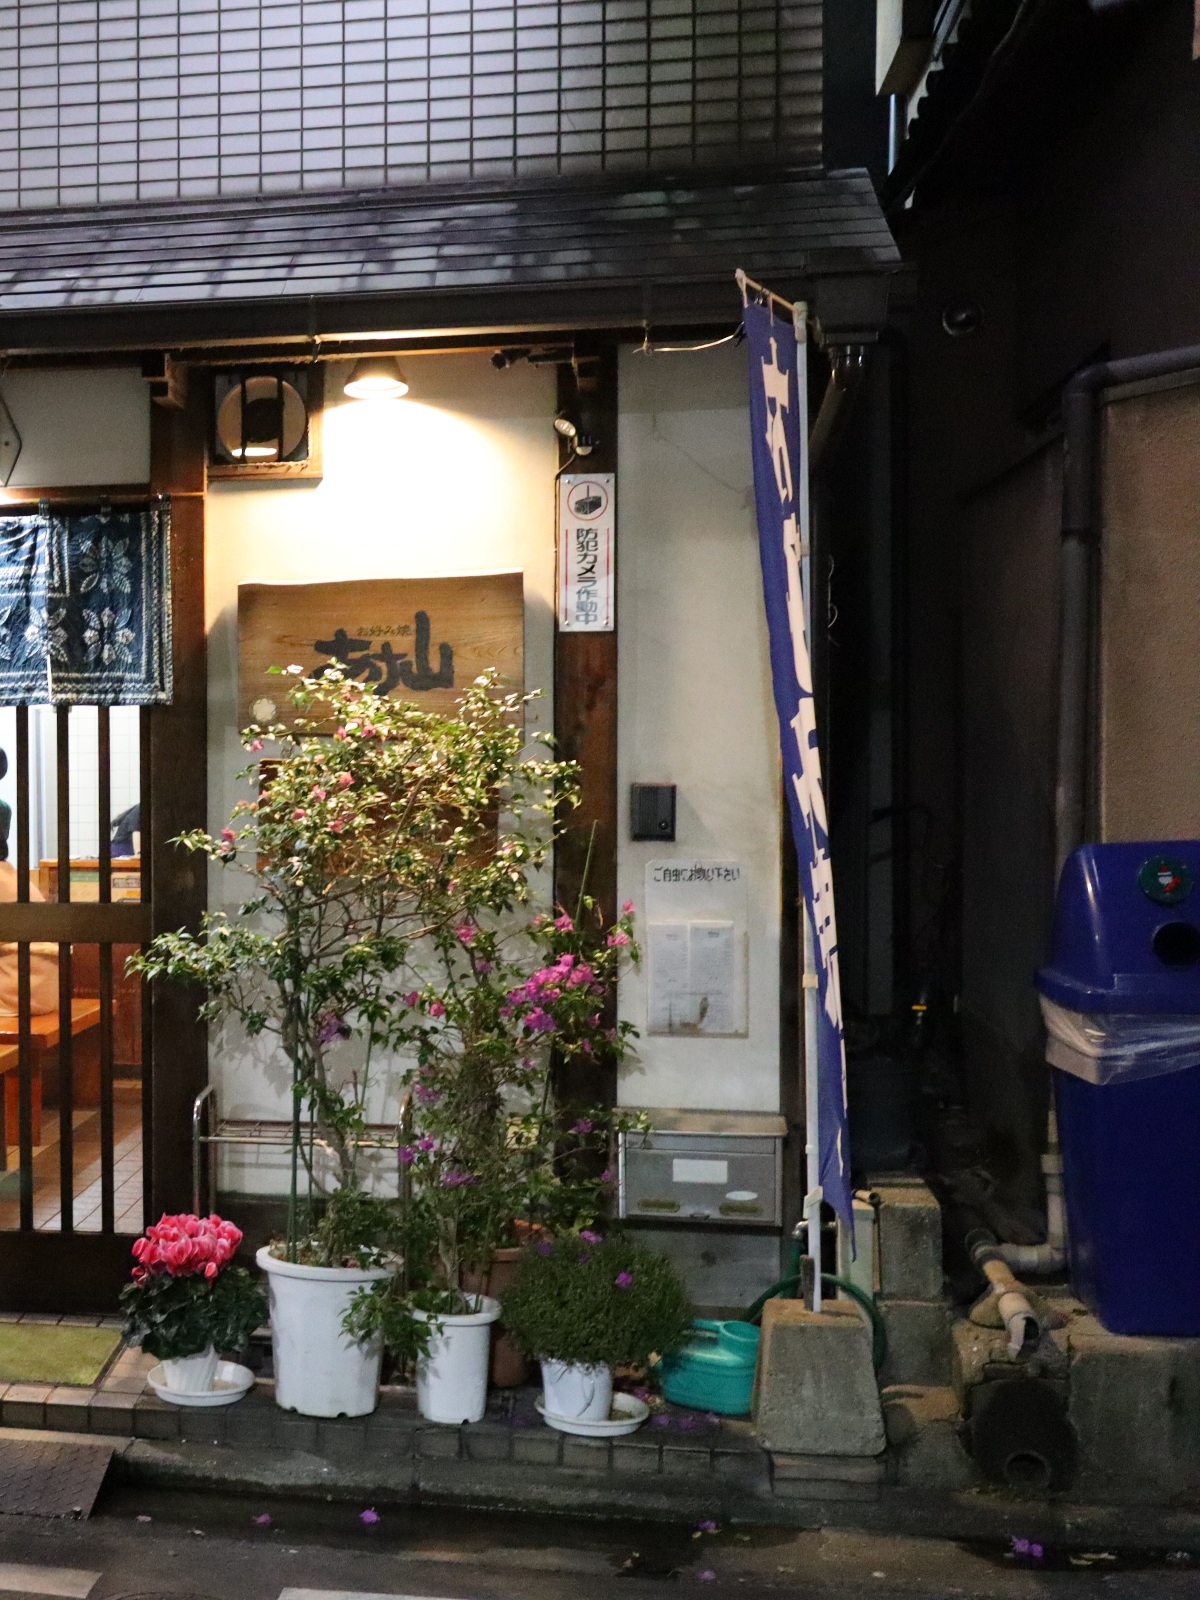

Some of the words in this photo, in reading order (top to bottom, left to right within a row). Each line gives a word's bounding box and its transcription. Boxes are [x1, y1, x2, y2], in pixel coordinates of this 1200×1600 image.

[575, 527, 598, 625] 防犯カメラ作動中
[356, 624, 413, 637] お好み焼
